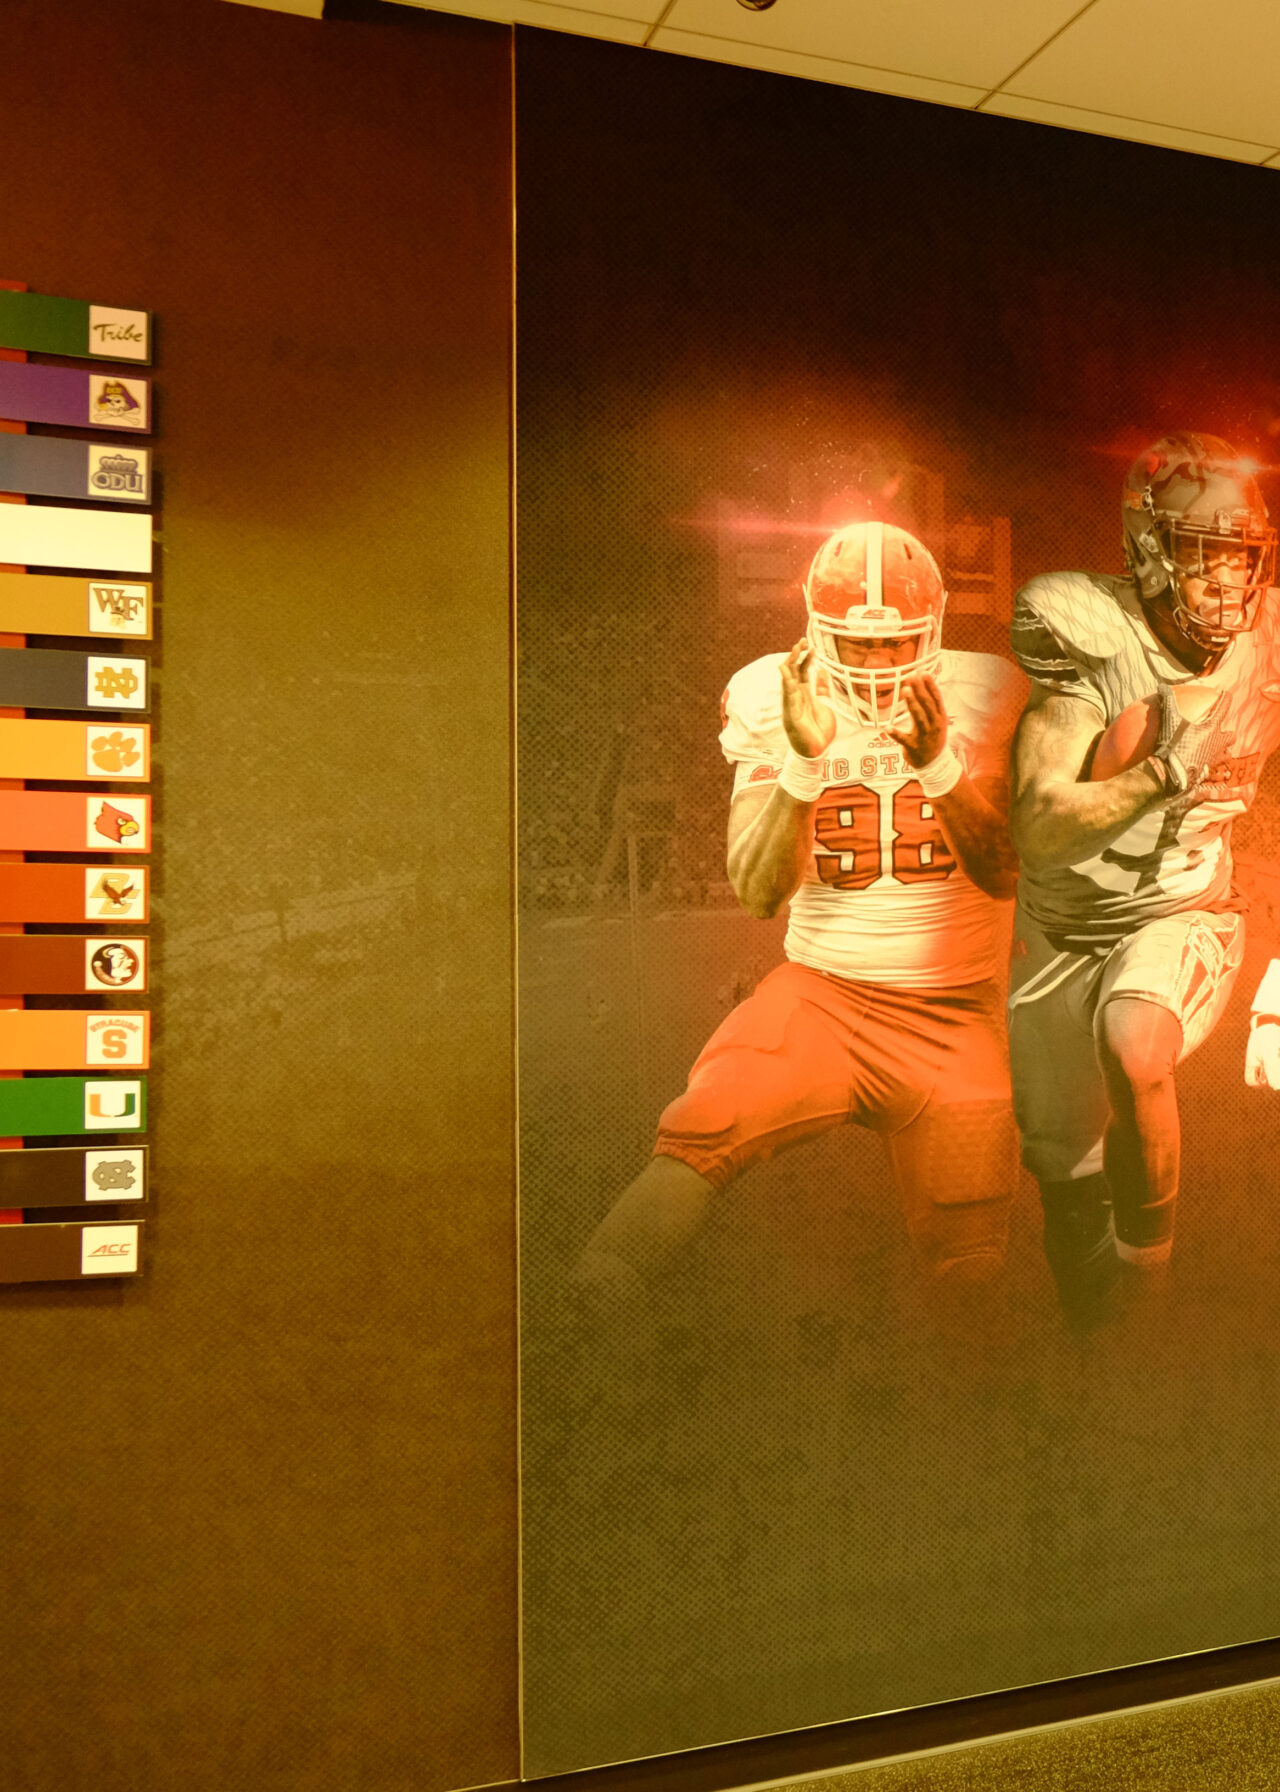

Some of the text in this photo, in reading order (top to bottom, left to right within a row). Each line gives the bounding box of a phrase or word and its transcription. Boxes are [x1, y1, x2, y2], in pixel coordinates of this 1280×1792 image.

[93, 323, 143, 342] Tribe
[91, 470, 143, 493] ODU
[814, 779, 958, 890] 98
[102, 1029, 127, 1058] S
[89, 1093, 136, 1118] U
[91, 1243, 132, 1255] ACC
